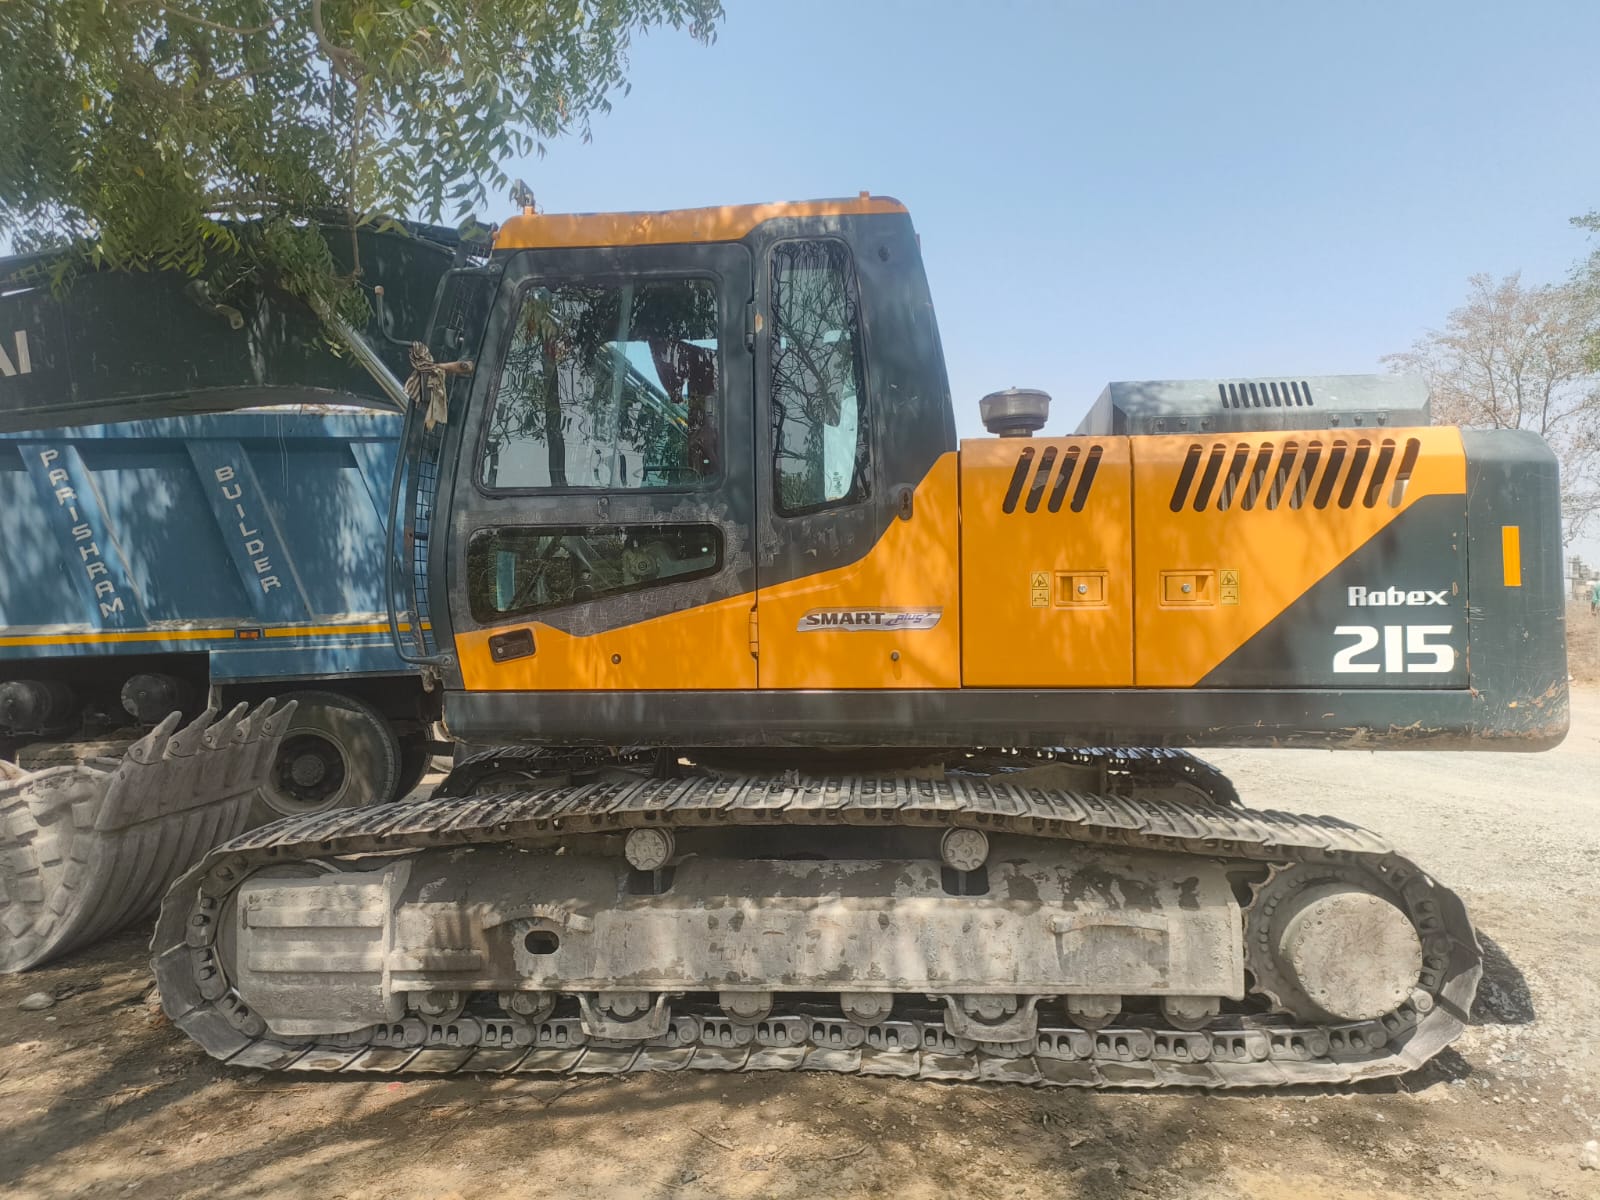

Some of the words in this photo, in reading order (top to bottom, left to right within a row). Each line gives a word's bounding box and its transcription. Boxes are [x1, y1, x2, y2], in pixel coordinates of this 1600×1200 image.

[40, 449, 125, 619] PARISHRAM
[215, 465, 281, 594] BUILDER
[806, 612, 885, 626] SMART
[890, 612, 929, 626] plus
[1347, 586, 1449, 606] Robex
[1333, 625, 1455, 673] 215
